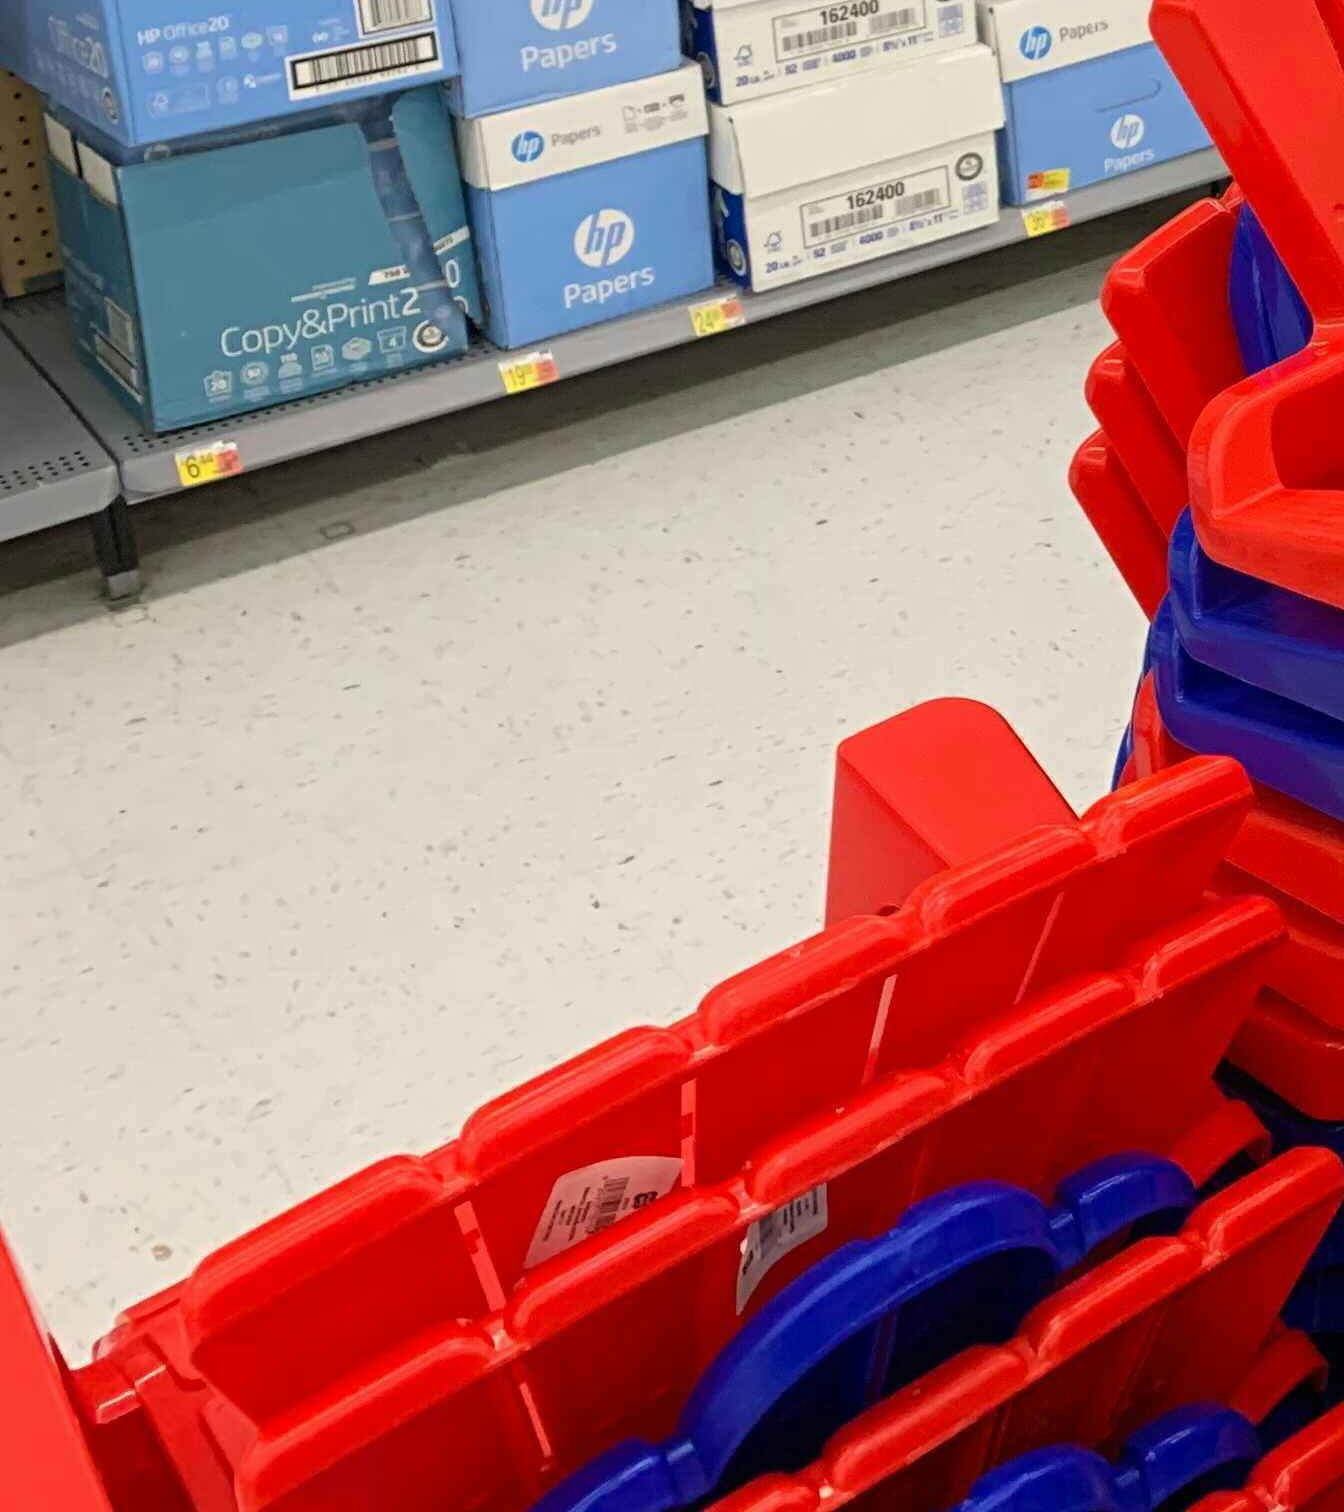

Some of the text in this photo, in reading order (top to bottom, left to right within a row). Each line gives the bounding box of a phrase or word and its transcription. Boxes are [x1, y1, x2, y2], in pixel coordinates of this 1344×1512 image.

[137, 28, 161, 46] HP
[1059, 19, 1110, 41] Papers
[519, 33, 618, 73] Papers
[551, 125, 601, 147] Papers
[1113, 115, 1142, 150] hp
[1104, 147, 1155, 173] Papers
[846, 181, 905, 210] 162400
[581, 208, 630, 268] hp
[563, 267, 656, 309] Papers
